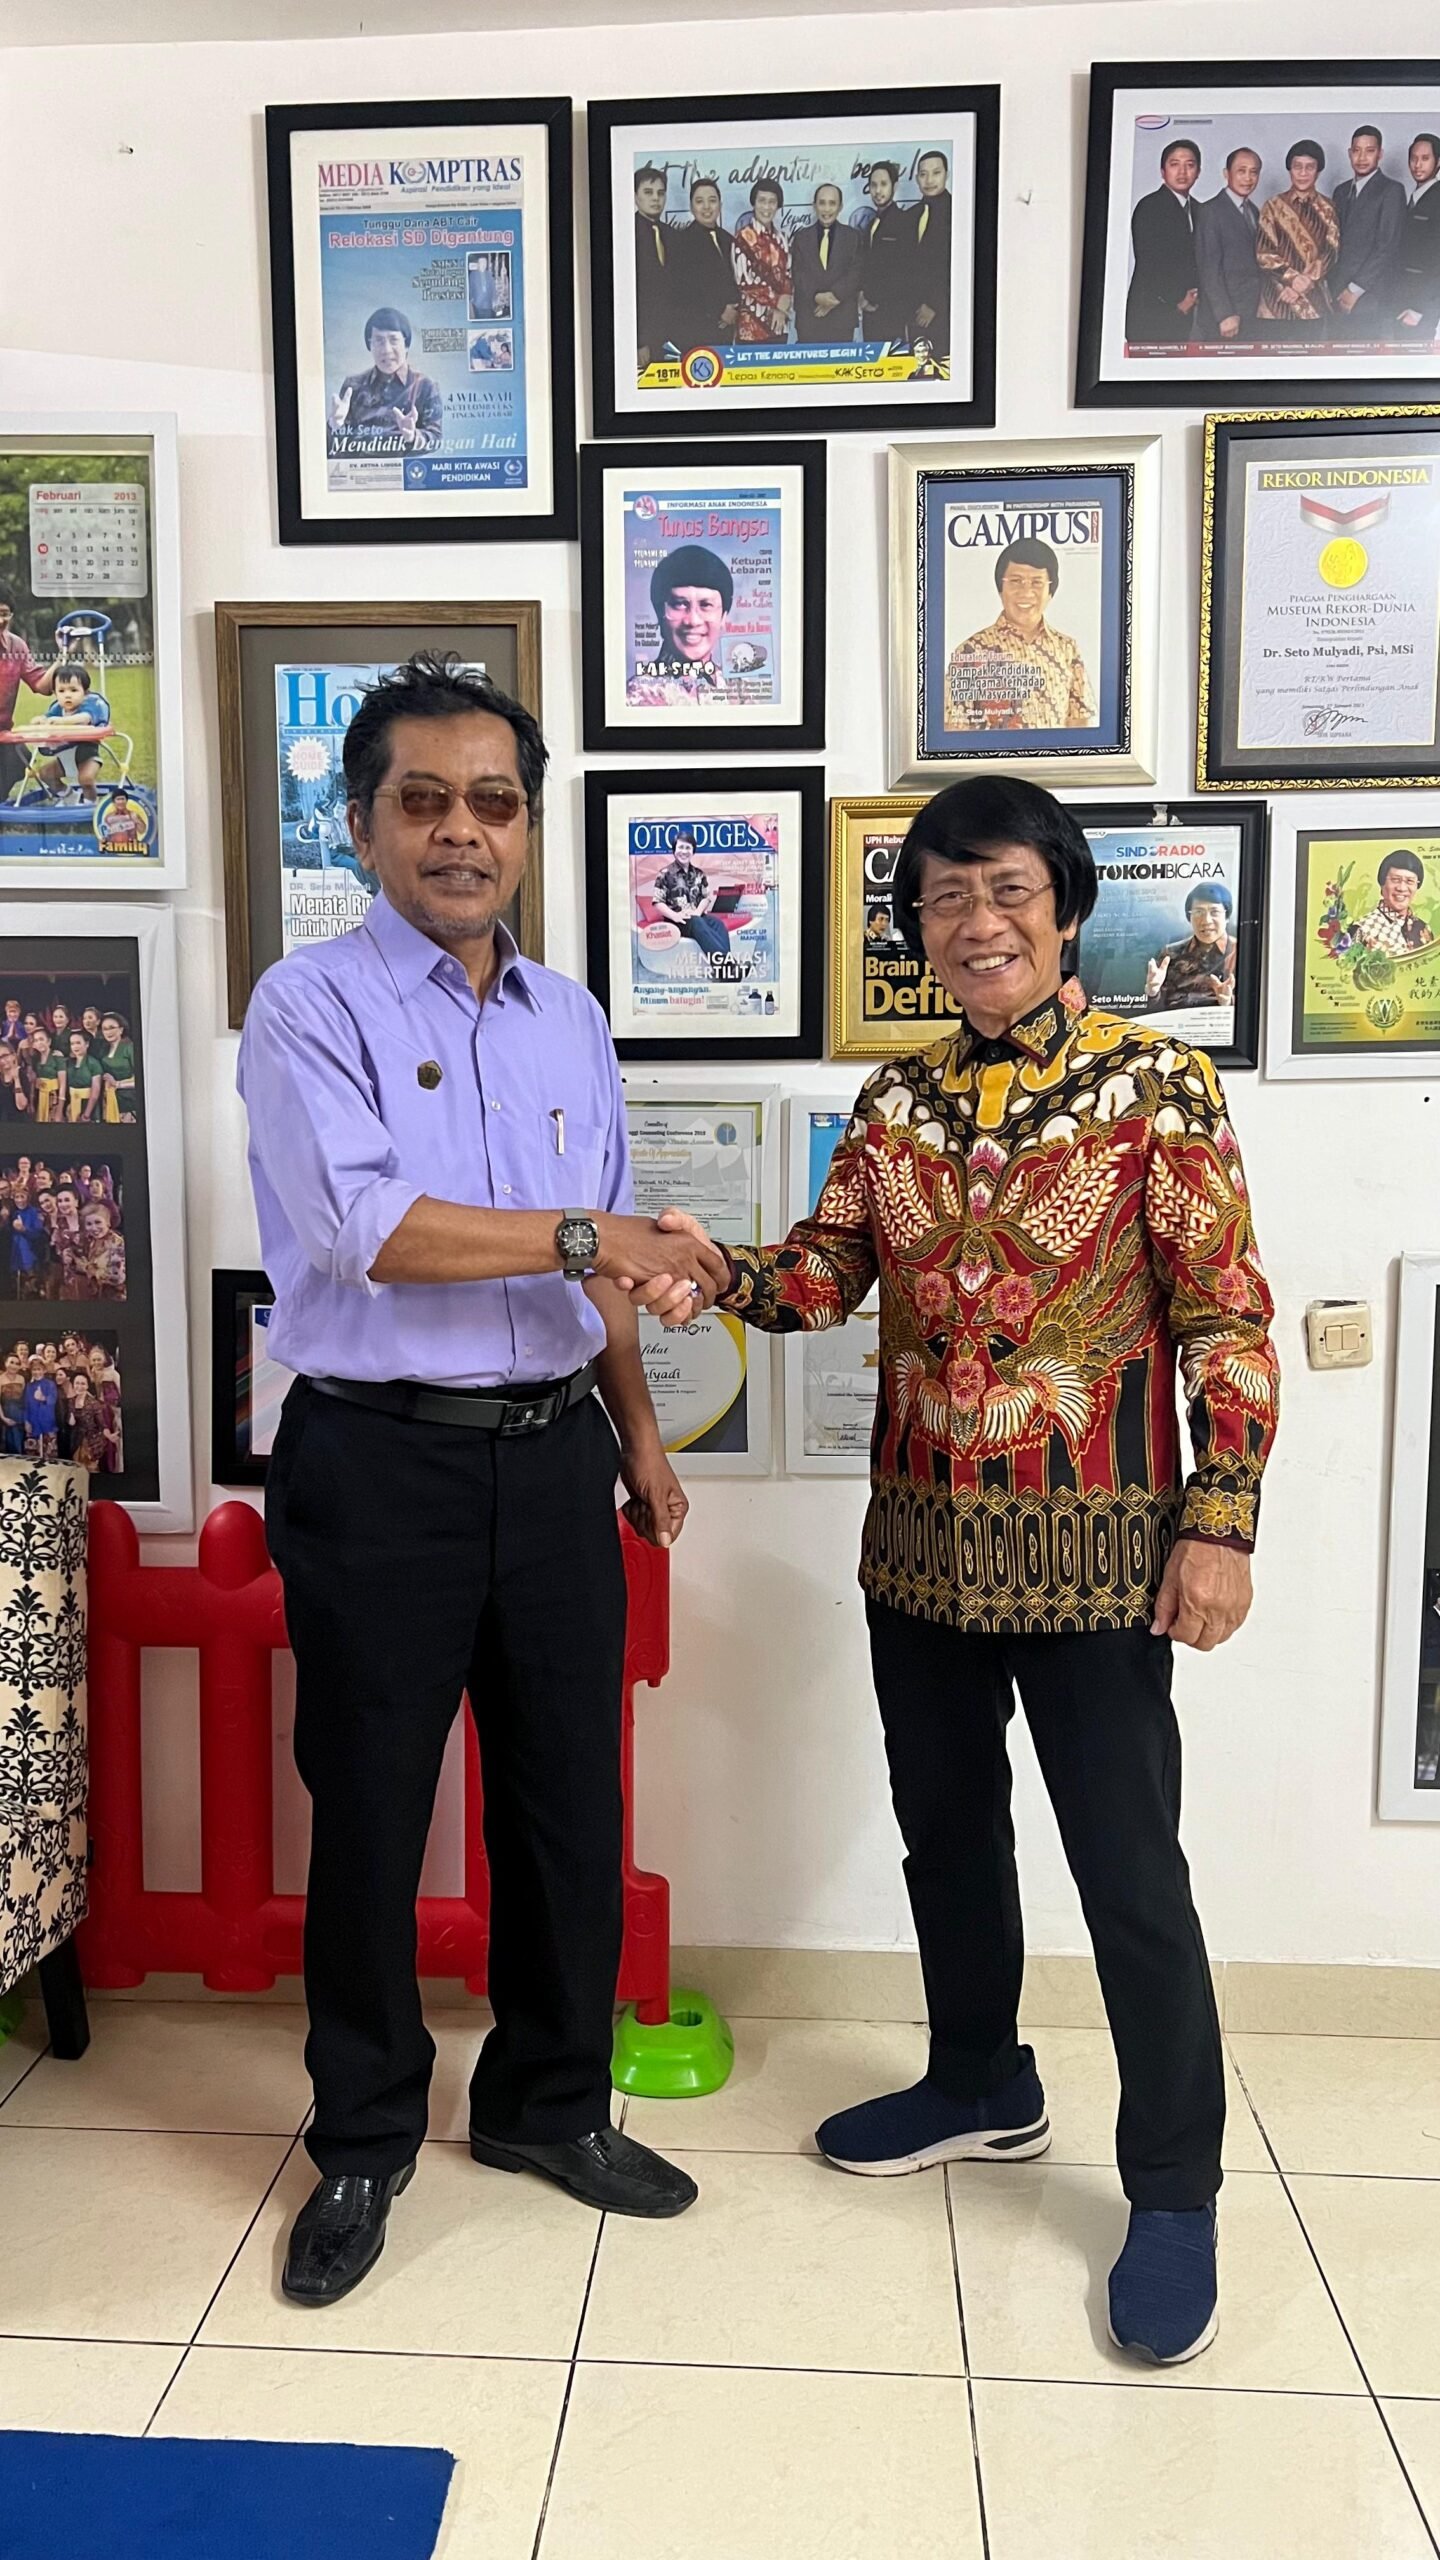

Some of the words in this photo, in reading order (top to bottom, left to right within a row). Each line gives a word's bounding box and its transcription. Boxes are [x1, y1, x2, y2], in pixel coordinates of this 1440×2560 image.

[318, 163, 384, 188] MEDIA
[389, 157, 521, 186] KOMPTRAS
[362, 219, 401, 231] Tunggu
[403, 218, 429, 228] Dana
[456, 216, 479, 226] Cair
[328, 231, 399, 249] Relokasi
[402, 230, 427, 247] SD
[429, 227, 514, 248] Digantung
[411, 277, 466, 289] Segudang
[421, 288, 466, 301] Prestasi
[737, 350, 752, 361] LET
[754, 350, 771, 360] THE
[772, 348, 829, 360] ADVENTURES
[656, 368, 681, 380] 18TH
[834, 368, 854, 378] KAK
[854, 366, 885, 379] SETO
[455, 391, 513, 402] WILAYAH
[356, 424, 385, 436] Seto
[329, 436, 407, 456] Mendidik
[411, 436, 477, 454] Dengan
[480, 432, 518, 450] Hati
[431, 462, 453, 472] MARI
[454, 461, 473, 471] KITA
[474, 461, 500, 471] AWASI
[441, 472, 491, 483] PENDIDIKAN
[1262, 471, 1323, 489] REKOR
[1326, 468, 1430, 487] INDONESIA
[36, 490, 81, 501] Februari
[114, 492, 137, 501] 2013
[666, 501, 707, 509] INFORMASI
[728, 500, 768, 508] INDONESIA
[658, 514, 705, 539] Tunas
[707, 512, 770, 543] Bangsa
[947, 510, 1091, 548] CAMPUS
[731, 556, 772, 568] Ketupat
[730, 566, 772, 575] Lebaran
[1289, 594, 1325, 603] PIAGAM
[1327, 592, 1397, 603] PENGHARGAAN
[1267, 606, 1322, 616] MUSEUM
[1326, 602, 1417, 614] REKOR-DUNIA
[1305, 616, 1377, 628] INDONESIA
[1262, 648, 1282, 658] Dr.
[1284, 647, 1310, 658] Seto
[1312, 645, 1365, 659] Mulyadi,
[1366, 645, 1388, 657] Psi,
[1390, 644, 1414, 655] MSi
[635, 661, 671, 677] KAK
[671, 660, 716, 679] SETO
[950, 665, 988, 679] Dampak
[990, 664, 1042, 676] Pendidikan
[950, 678, 969, 689] dan
[970, 678, 1002, 691] Agama
[1003, 676, 1046, 689] terhadap
[950, 690, 977, 701] Moral
[978, 688, 1031, 702] Masyarakat
[1255, 687, 1275, 696] yang
[283, 672, 361, 728] Ho
[634, 824, 680, 850] OTC
[692, 823, 768, 849] DIGES
[865, 836, 882, 844] UPH
[883, 835, 906, 844] Rebu
[99, 839, 149, 857] Family
[289, 882, 306, 891] DR.
[289, 893, 348, 916] Menata
[350, 893, 373, 916] Ru
[865, 893, 893, 903] Morali
[290, 917, 329, 937] Untuk
[675, 950, 768, 965] MENGATASI
[669, 964, 768, 980] INFERTILITAS
[865, 954, 919, 977] Brain
[640, 997, 669, 1005] Minum
[865, 975, 964, 1016] Defic
[1091, 995, 1112, 1004] Seto
[1113, 994, 1148, 1005] Mulyadi
